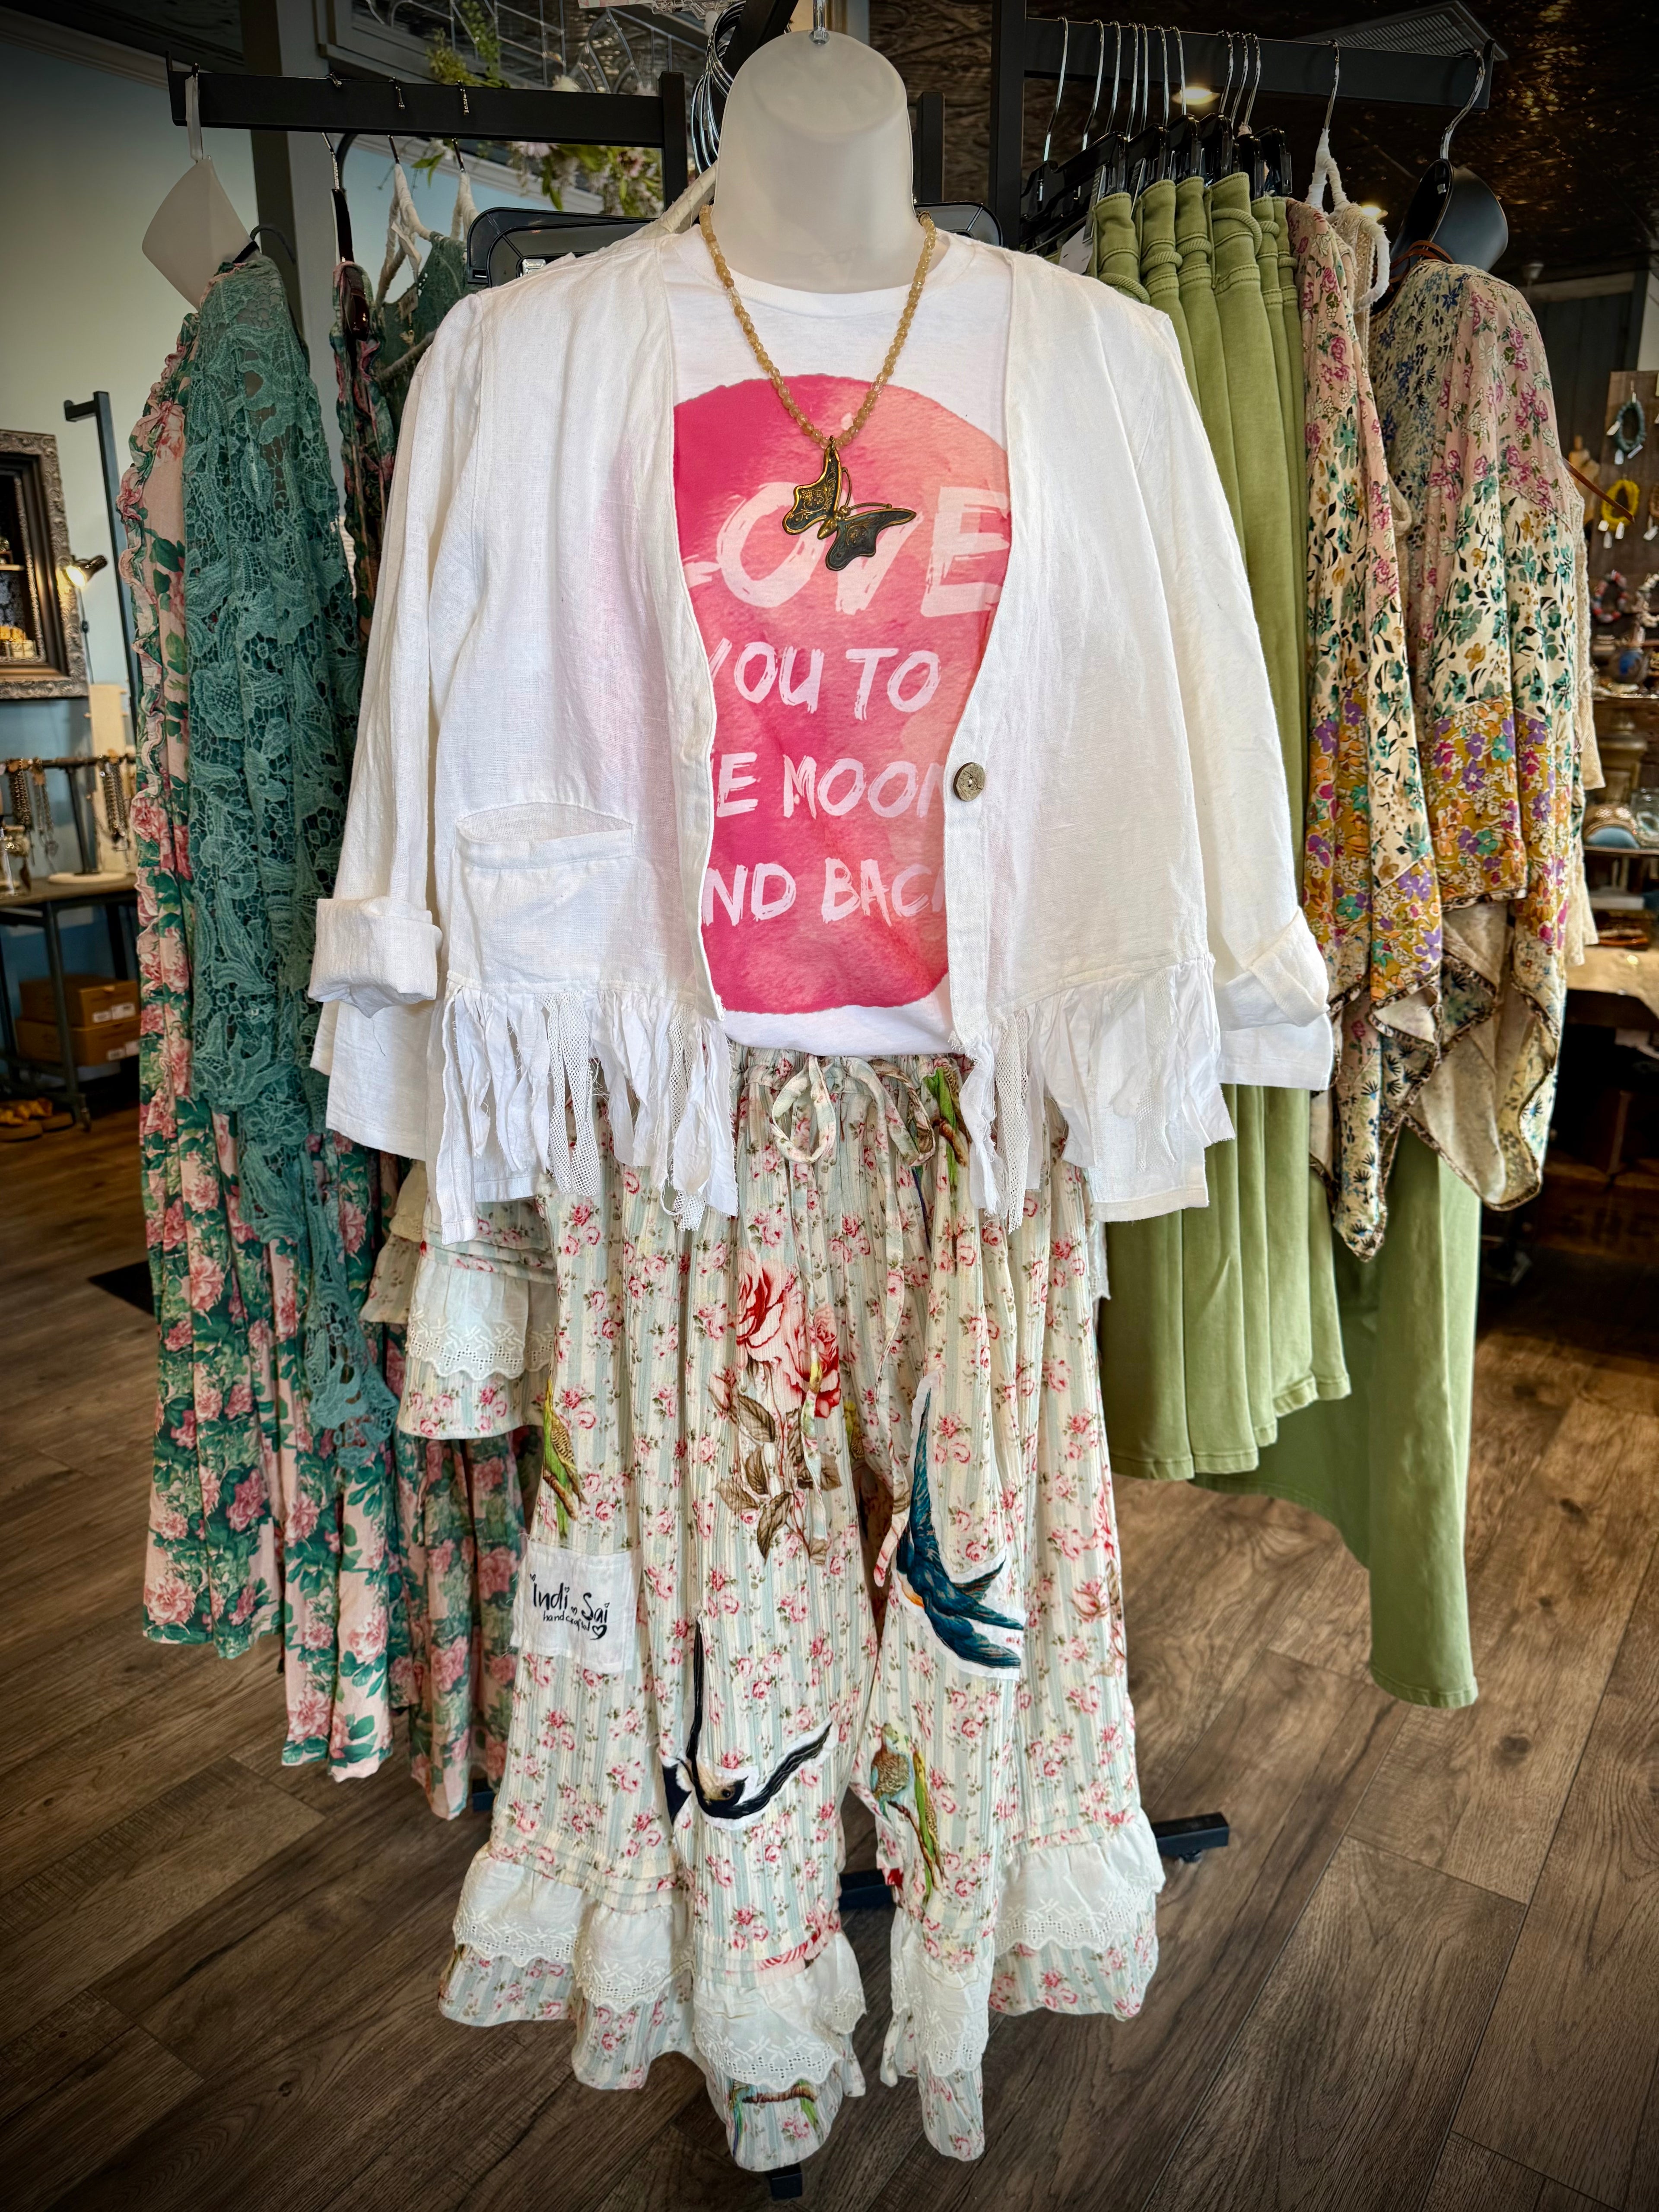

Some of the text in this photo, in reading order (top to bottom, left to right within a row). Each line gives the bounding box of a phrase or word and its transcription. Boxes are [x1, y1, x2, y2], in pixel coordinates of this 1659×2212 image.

[845, 648, 941, 721] TO
[530, 1573, 610, 1623] Indi Sai
